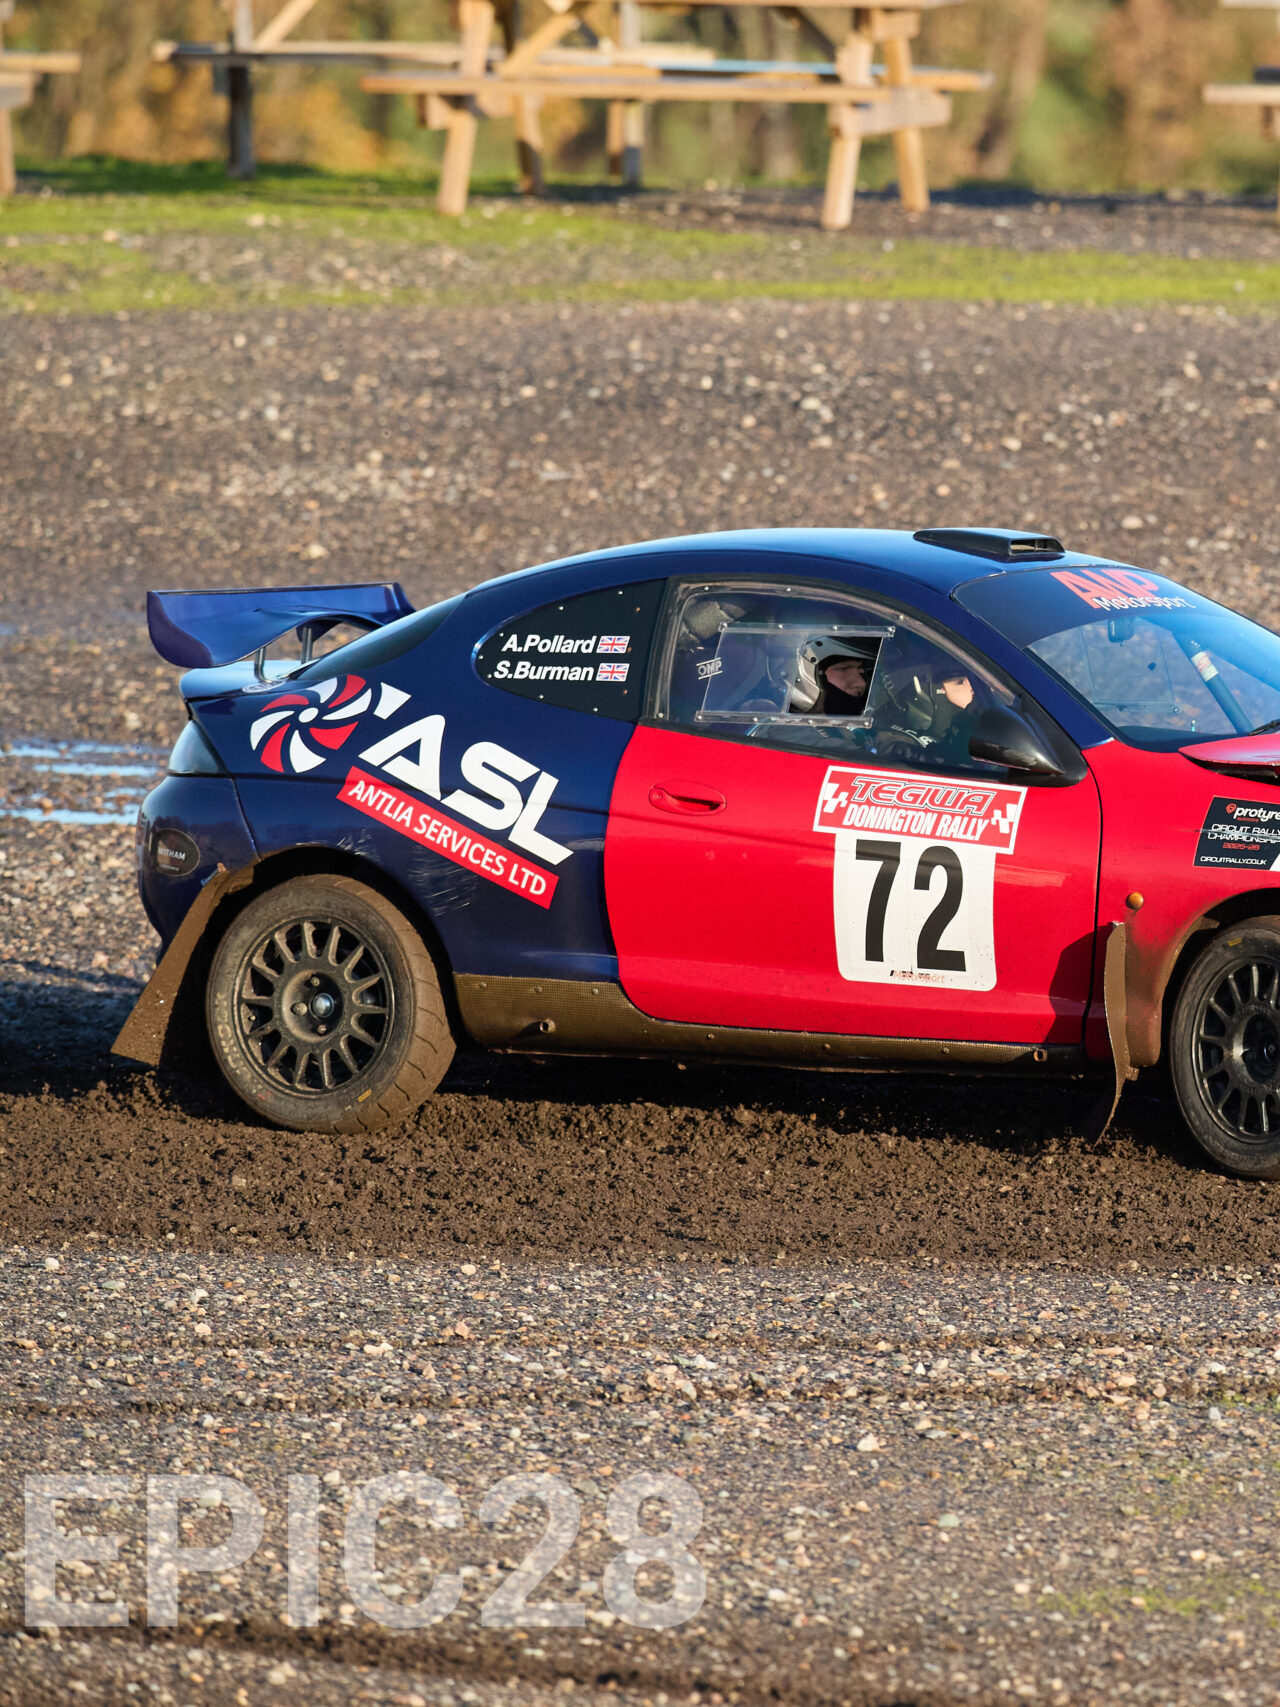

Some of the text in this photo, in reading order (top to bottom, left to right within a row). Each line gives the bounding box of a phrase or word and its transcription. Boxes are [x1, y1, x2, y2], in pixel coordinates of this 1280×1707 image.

[1091, 596, 1196, 611] Motorsport
[501, 633, 597, 654] A.Pollard
[493, 660, 595, 681] S.Burman
[697, 659, 722, 677] OMP
[359, 714, 574, 866] ASL
[852, 776, 996, 815] TEGIWA
[842, 804, 989, 841] DONINGTON RALLY
[1211, 823, 1251, 833] CIRCUIT
[348, 779, 547, 897] ANTLIA SERVICES LTD
[856, 838, 967, 972] 72
